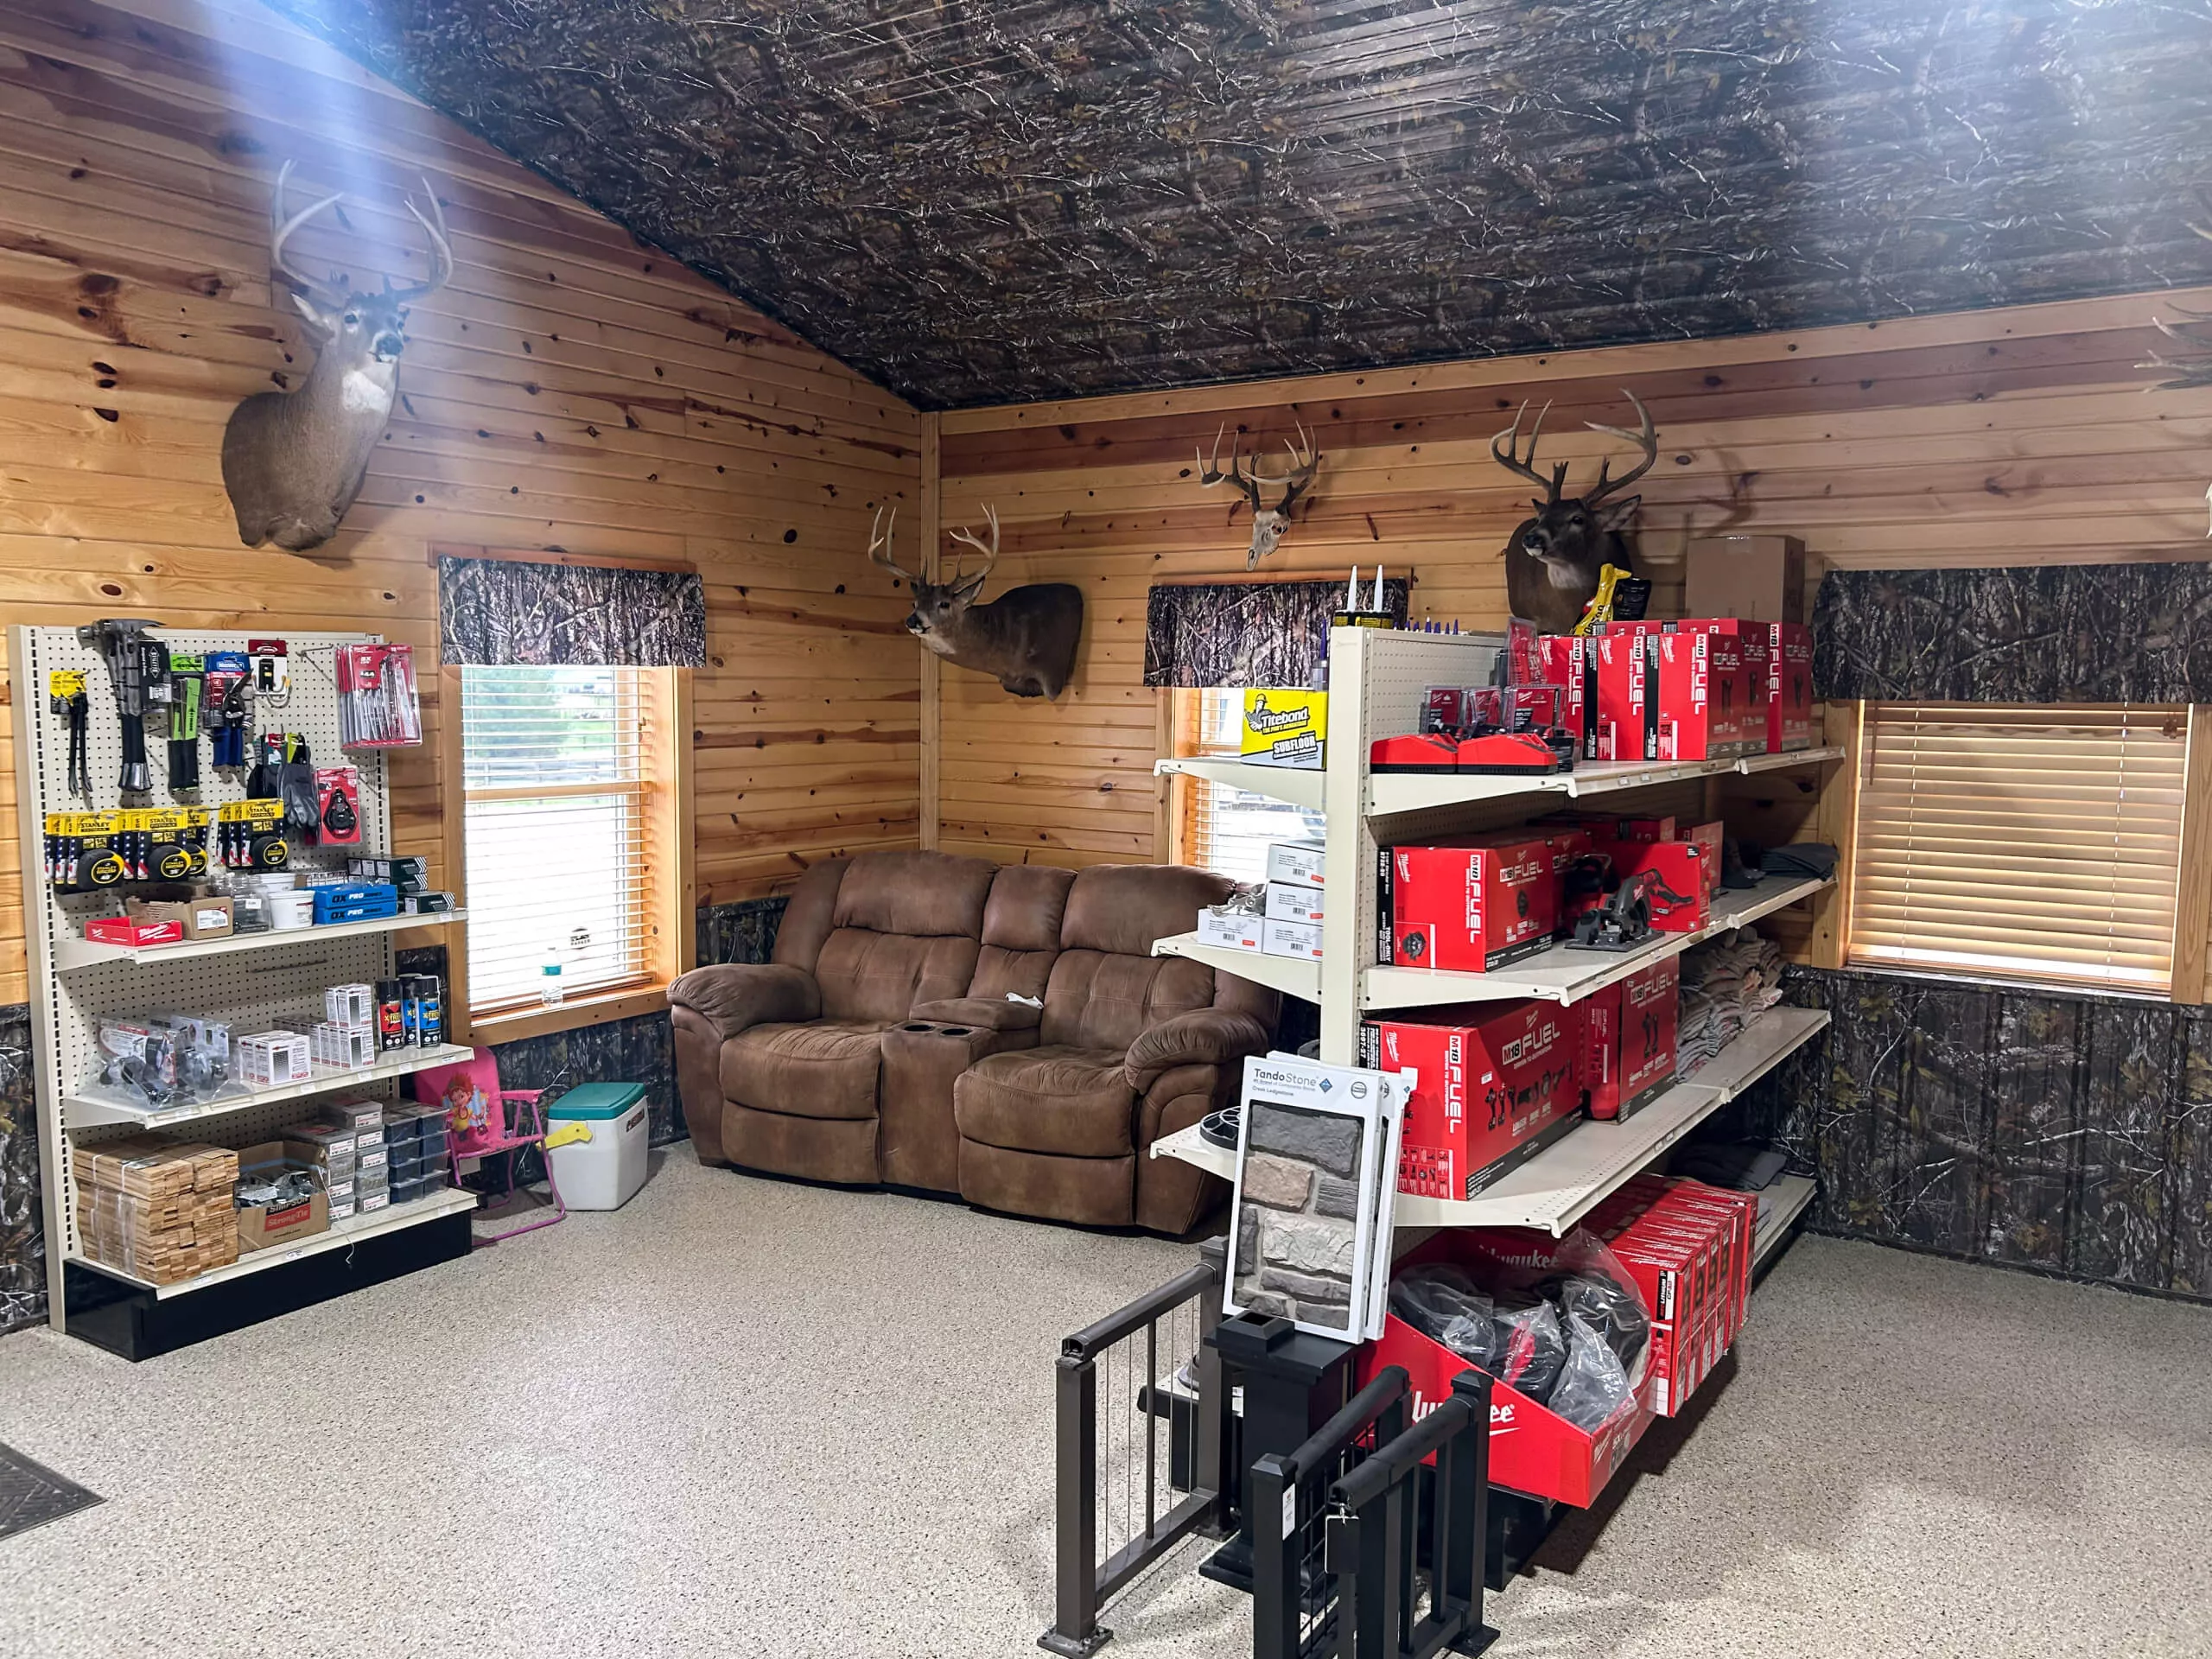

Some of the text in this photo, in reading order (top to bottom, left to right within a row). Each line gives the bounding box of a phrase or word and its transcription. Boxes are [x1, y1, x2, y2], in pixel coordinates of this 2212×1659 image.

[1572, 663, 1582, 715] FUEL
[1633, 662, 1643, 715] FUEL
[1695, 660, 1706, 715] FUEL
[1770, 649, 1779, 702] FUEL
[1262, 708, 1308, 728] Titebond
[1274, 736, 1316, 753] SUBFLOOR
[1515, 861, 1543, 879] FUEL
[1470, 882, 1481, 944] FUEL
[1643, 972, 1673, 998] FUEL
[1503, 1021, 1560, 1064] M18 FUEL
[1255, 1068, 1317, 1086] TandoStone
[1450, 1036, 1461, 1134] M18 FUEL
